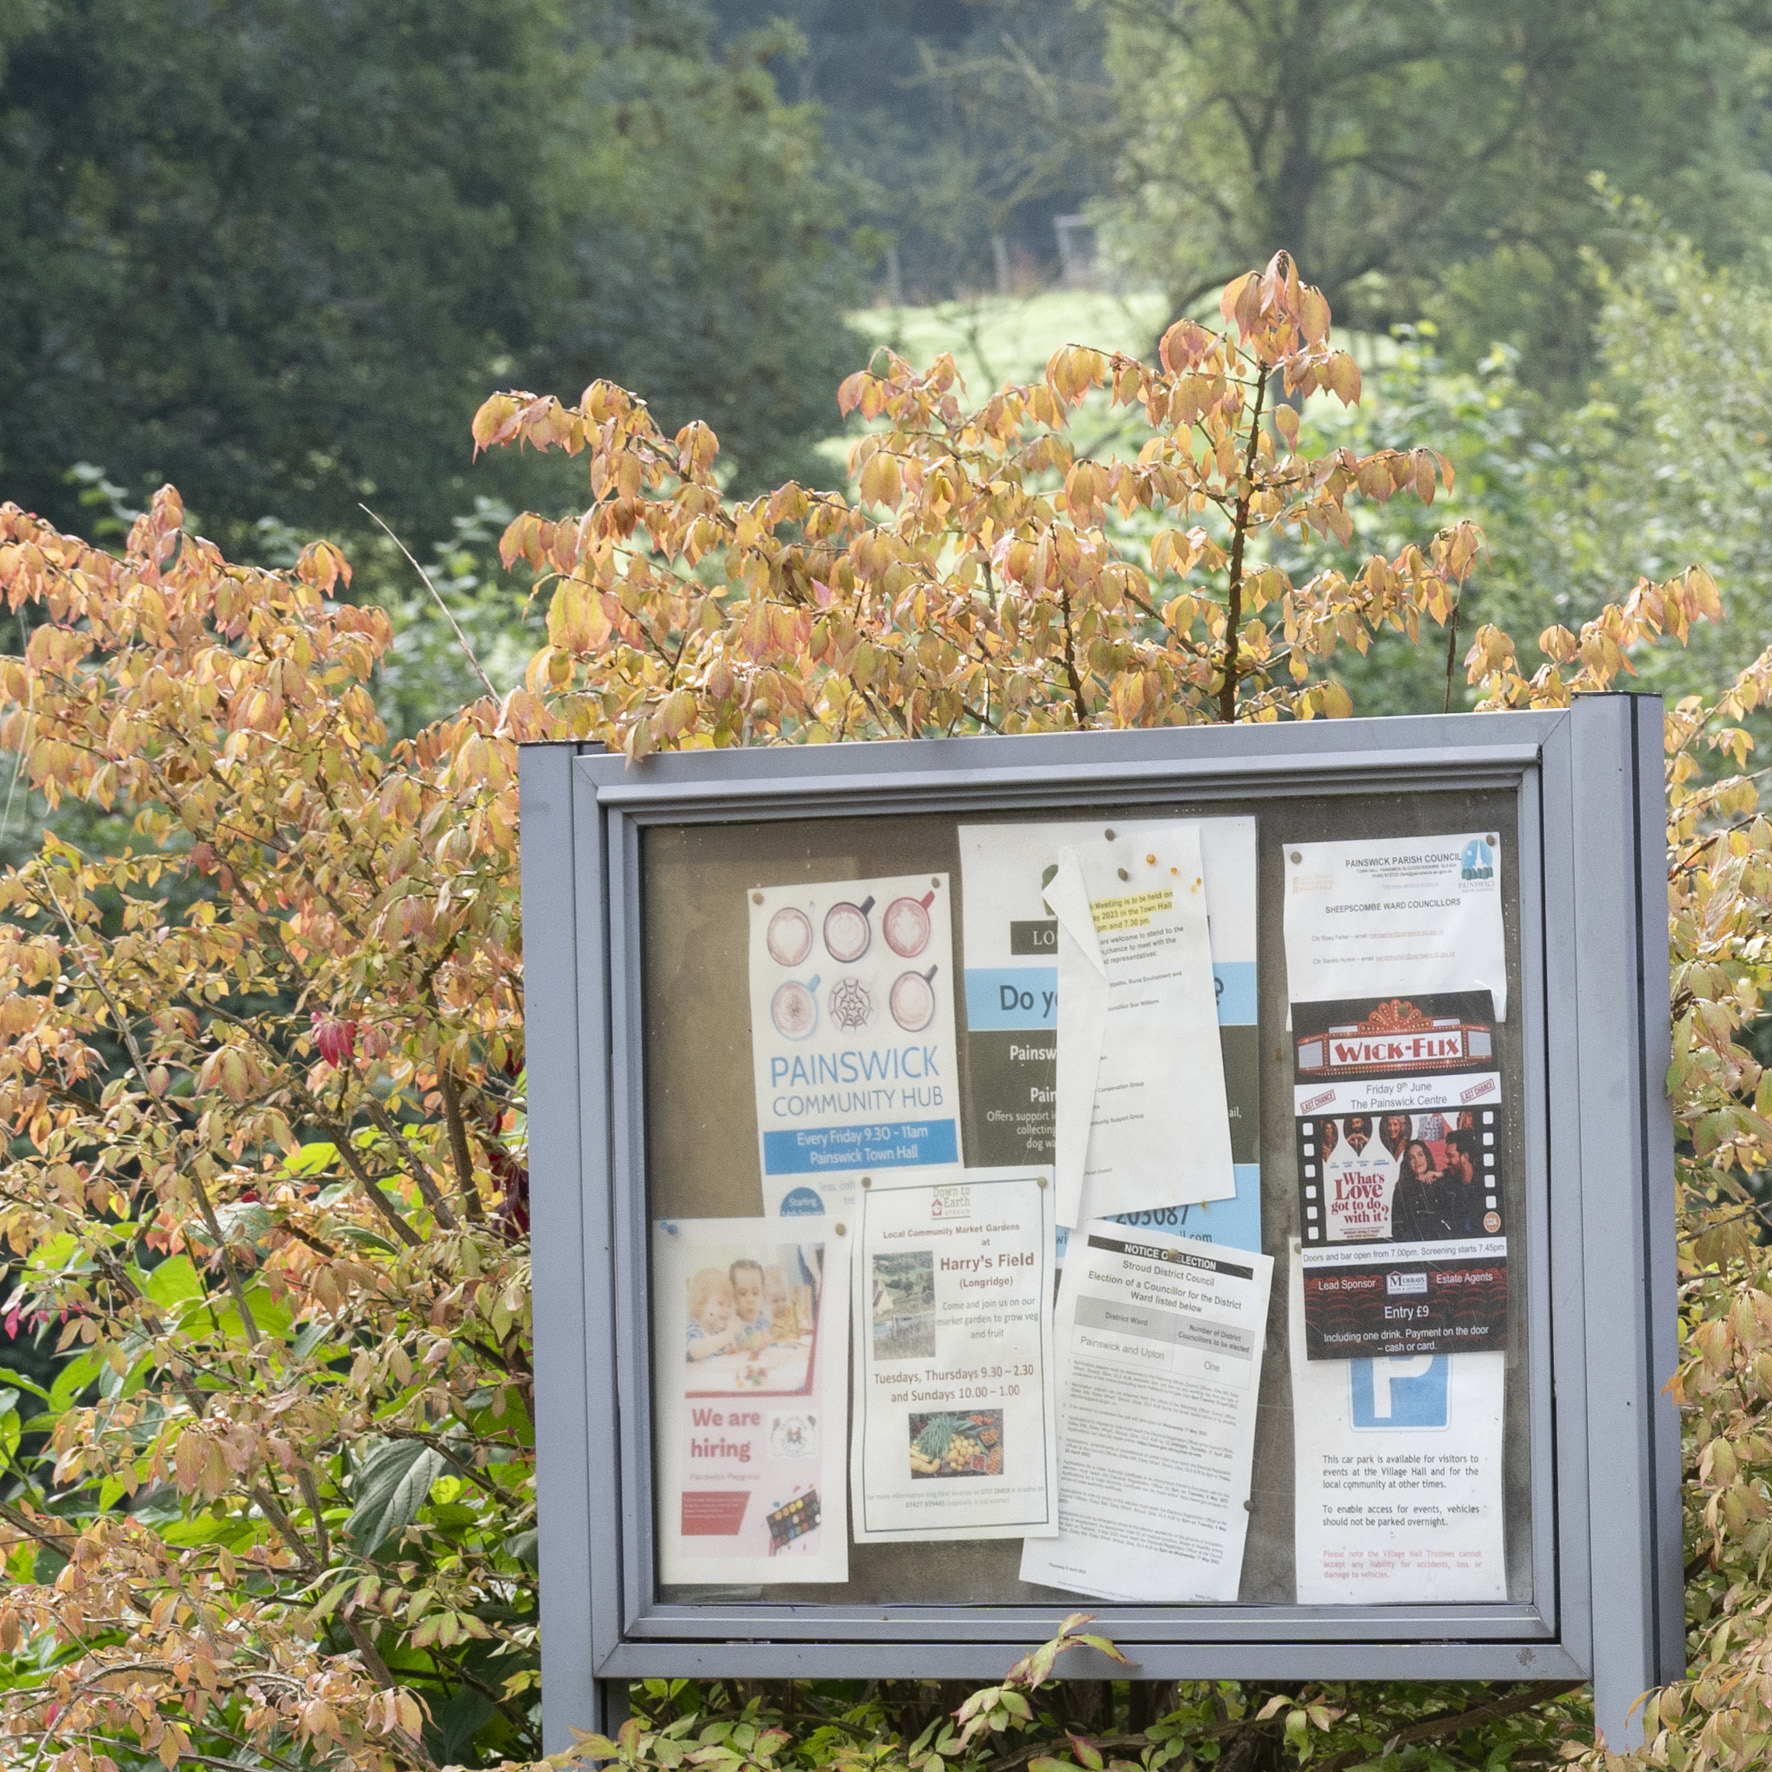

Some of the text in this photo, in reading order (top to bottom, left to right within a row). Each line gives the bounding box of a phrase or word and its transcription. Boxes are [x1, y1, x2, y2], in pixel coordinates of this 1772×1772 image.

[1346, 853, 1461, 868] PAINSWICK PARISH COUNCIL
[1325, 898, 1461, 914] SHEEPSCOMBE WARD COUNCILLORS
[1000, 985, 1034, 1011] Do
[1335, 1038, 1458, 1062] WICK-FLIX
[771, 1045, 940, 1087] PAINSWICK
[1366, 1082, 1431, 1096] Friday 9th June
[1462, 1083, 1493, 1102] LAST CHANCE
[773, 1086, 943, 1116] COMMUNITY HUB
[1303, 1093, 1334, 1111] LAST CHANCE
[1352, 1095, 1447, 1109] The Painswick Centre
[987, 1110, 1049, 1124] Offers support
[797, 1133, 827, 1148] Every
[830, 1129, 862, 1145] Friday
[864, 1127, 891, 1140] 9.30
[902, 1126, 928, 1138] 11am
[810, 1145, 919, 1164] Painswick Town Hall
[1343, 1172, 1384, 1185] What's
[933, 1187, 970, 1198] Down to
[1334, 1180, 1383, 1200] Love
[944, 1197, 970, 1208] Earth
[1331, 1201, 1349, 1215] got
[1352, 1201, 1363, 1210] to
[1344, 1205, 1389, 1223] with it?
[883, 1223, 1020, 1239] Local Community Market Gardens
[1124, 1243, 1159, 1258] NOTICE
[940, 1253, 1034, 1272] Harry's Field
[1123, 1260, 1215, 1286] Stroud District Council
[1319, 1272, 1493, 1292] Lead Sponsor Estate Agents
[959, 1276, 1013, 1290] (Longridge)
[1089, 1271, 1123, 1285] Election
[1126, 1279, 1134, 1287] of
[1144, 1281, 1186, 1298] Councillor
[1188, 1290, 1199, 1299] for
[1201, 1292, 1213, 1303] the
[1215, 1296, 1242, 1310] District
[1385, 1305, 1429, 1320] Entry £9
[1081, 1336, 1165, 1360] Painswick and Upton
[874, 1372, 921, 1384] Tuesdays,
[925, 1368, 978, 1382] Thursdays
[981, 1367, 1002, 1378] 9.30
[1014, 1365, 1034, 1376] 2.30
[1204, 1361, 1220, 1372] One
[891, 1392, 908, 1402] and
[911, 1390, 955, 1401] Sundays
[960, 1387, 987, 1398] 10.00
[1000, 1385, 1020, 1396] 1.00
[692, 1408, 760, 1427] We are
[691, 1438, 751, 1463] hiring
[1323, 1455, 1338, 1464] This
[1357, 1455, 1374, 1466] park
[1378, 1455, 1383, 1463] is
[1386, 1455, 1421, 1464] available
[1424, 1455, 1434, 1463] for
[1438, 1455, 1467, 1463] visitors
[1470, 1455, 1479, 1463] to
[1323, 1505, 1332, 1513] To
[1337, 1505, 1363, 1513] enable
[1397, 1505, 1408, 1513] for
[1413, 1505, 1442, 1514] events,
[1447, 1505, 1479, 1513] vehicles
